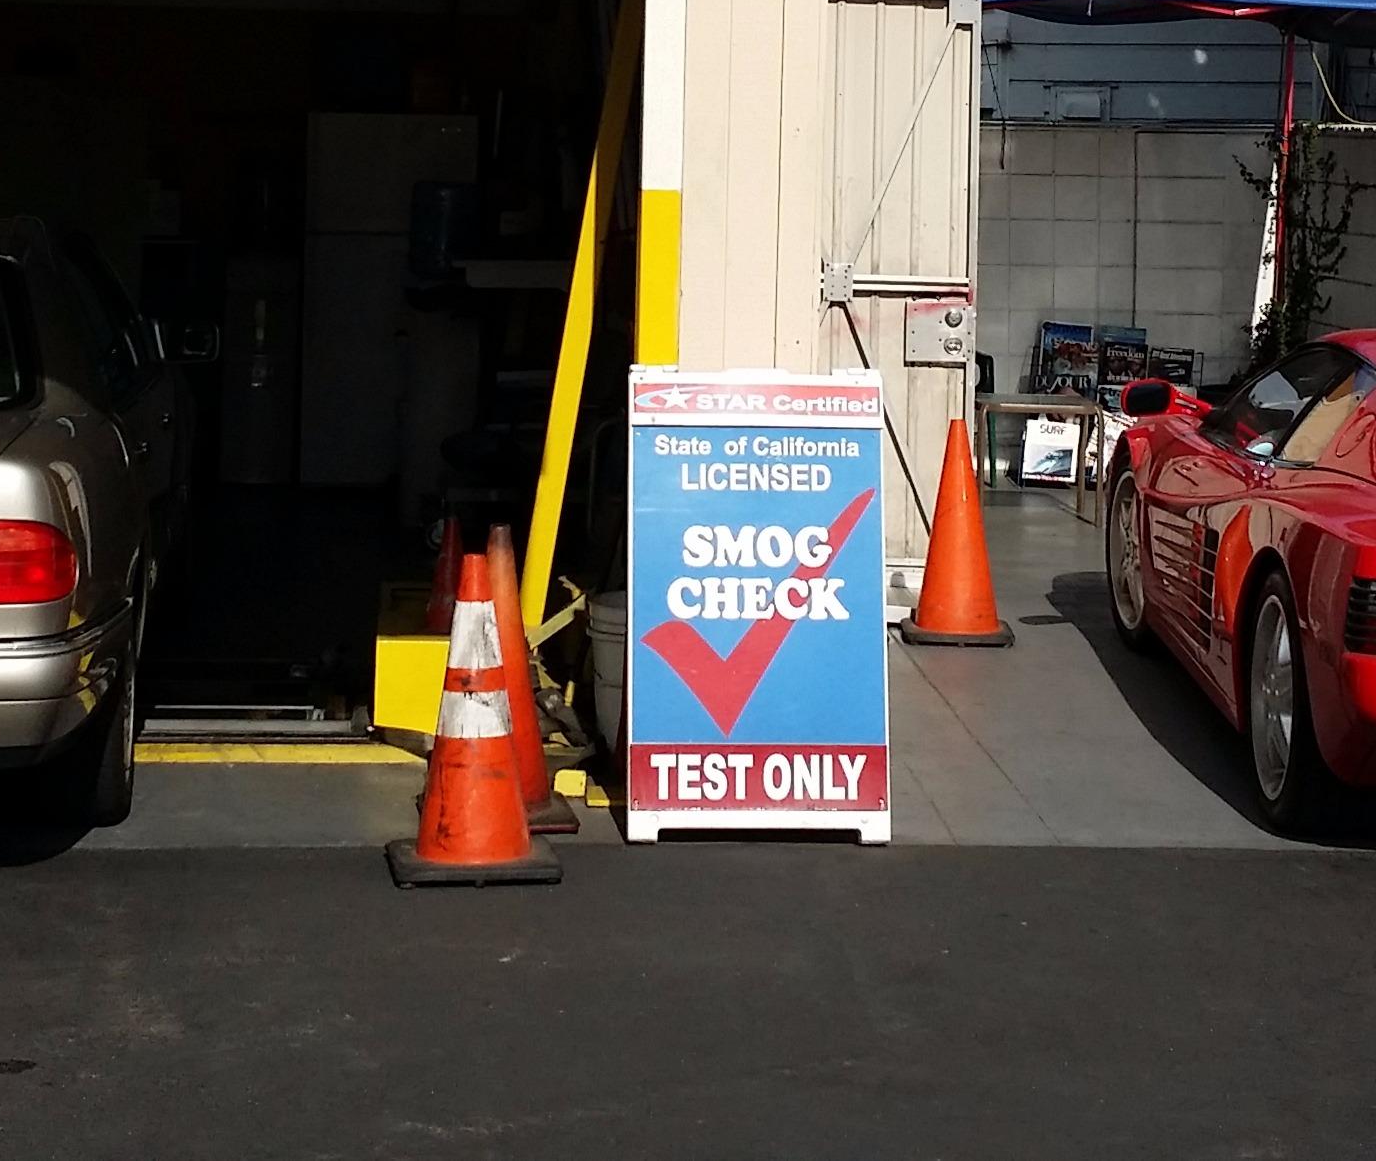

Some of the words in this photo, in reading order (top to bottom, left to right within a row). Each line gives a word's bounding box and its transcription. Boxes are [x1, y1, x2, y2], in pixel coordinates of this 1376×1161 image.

[695, 394, 767, 411] STAR
[773, 393, 879, 415] Certified
[654, 435, 712, 456] State
[724, 435, 748, 456] of
[752, 436, 860, 458] California
[681, 463, 832, 492] LICENSED
[682, 525, 832, 568] SMOG
[666, 577, 849, 620] CHECK
[650, 753, 754, 801] TEST
[763, 753, 867, 801] ONLY
